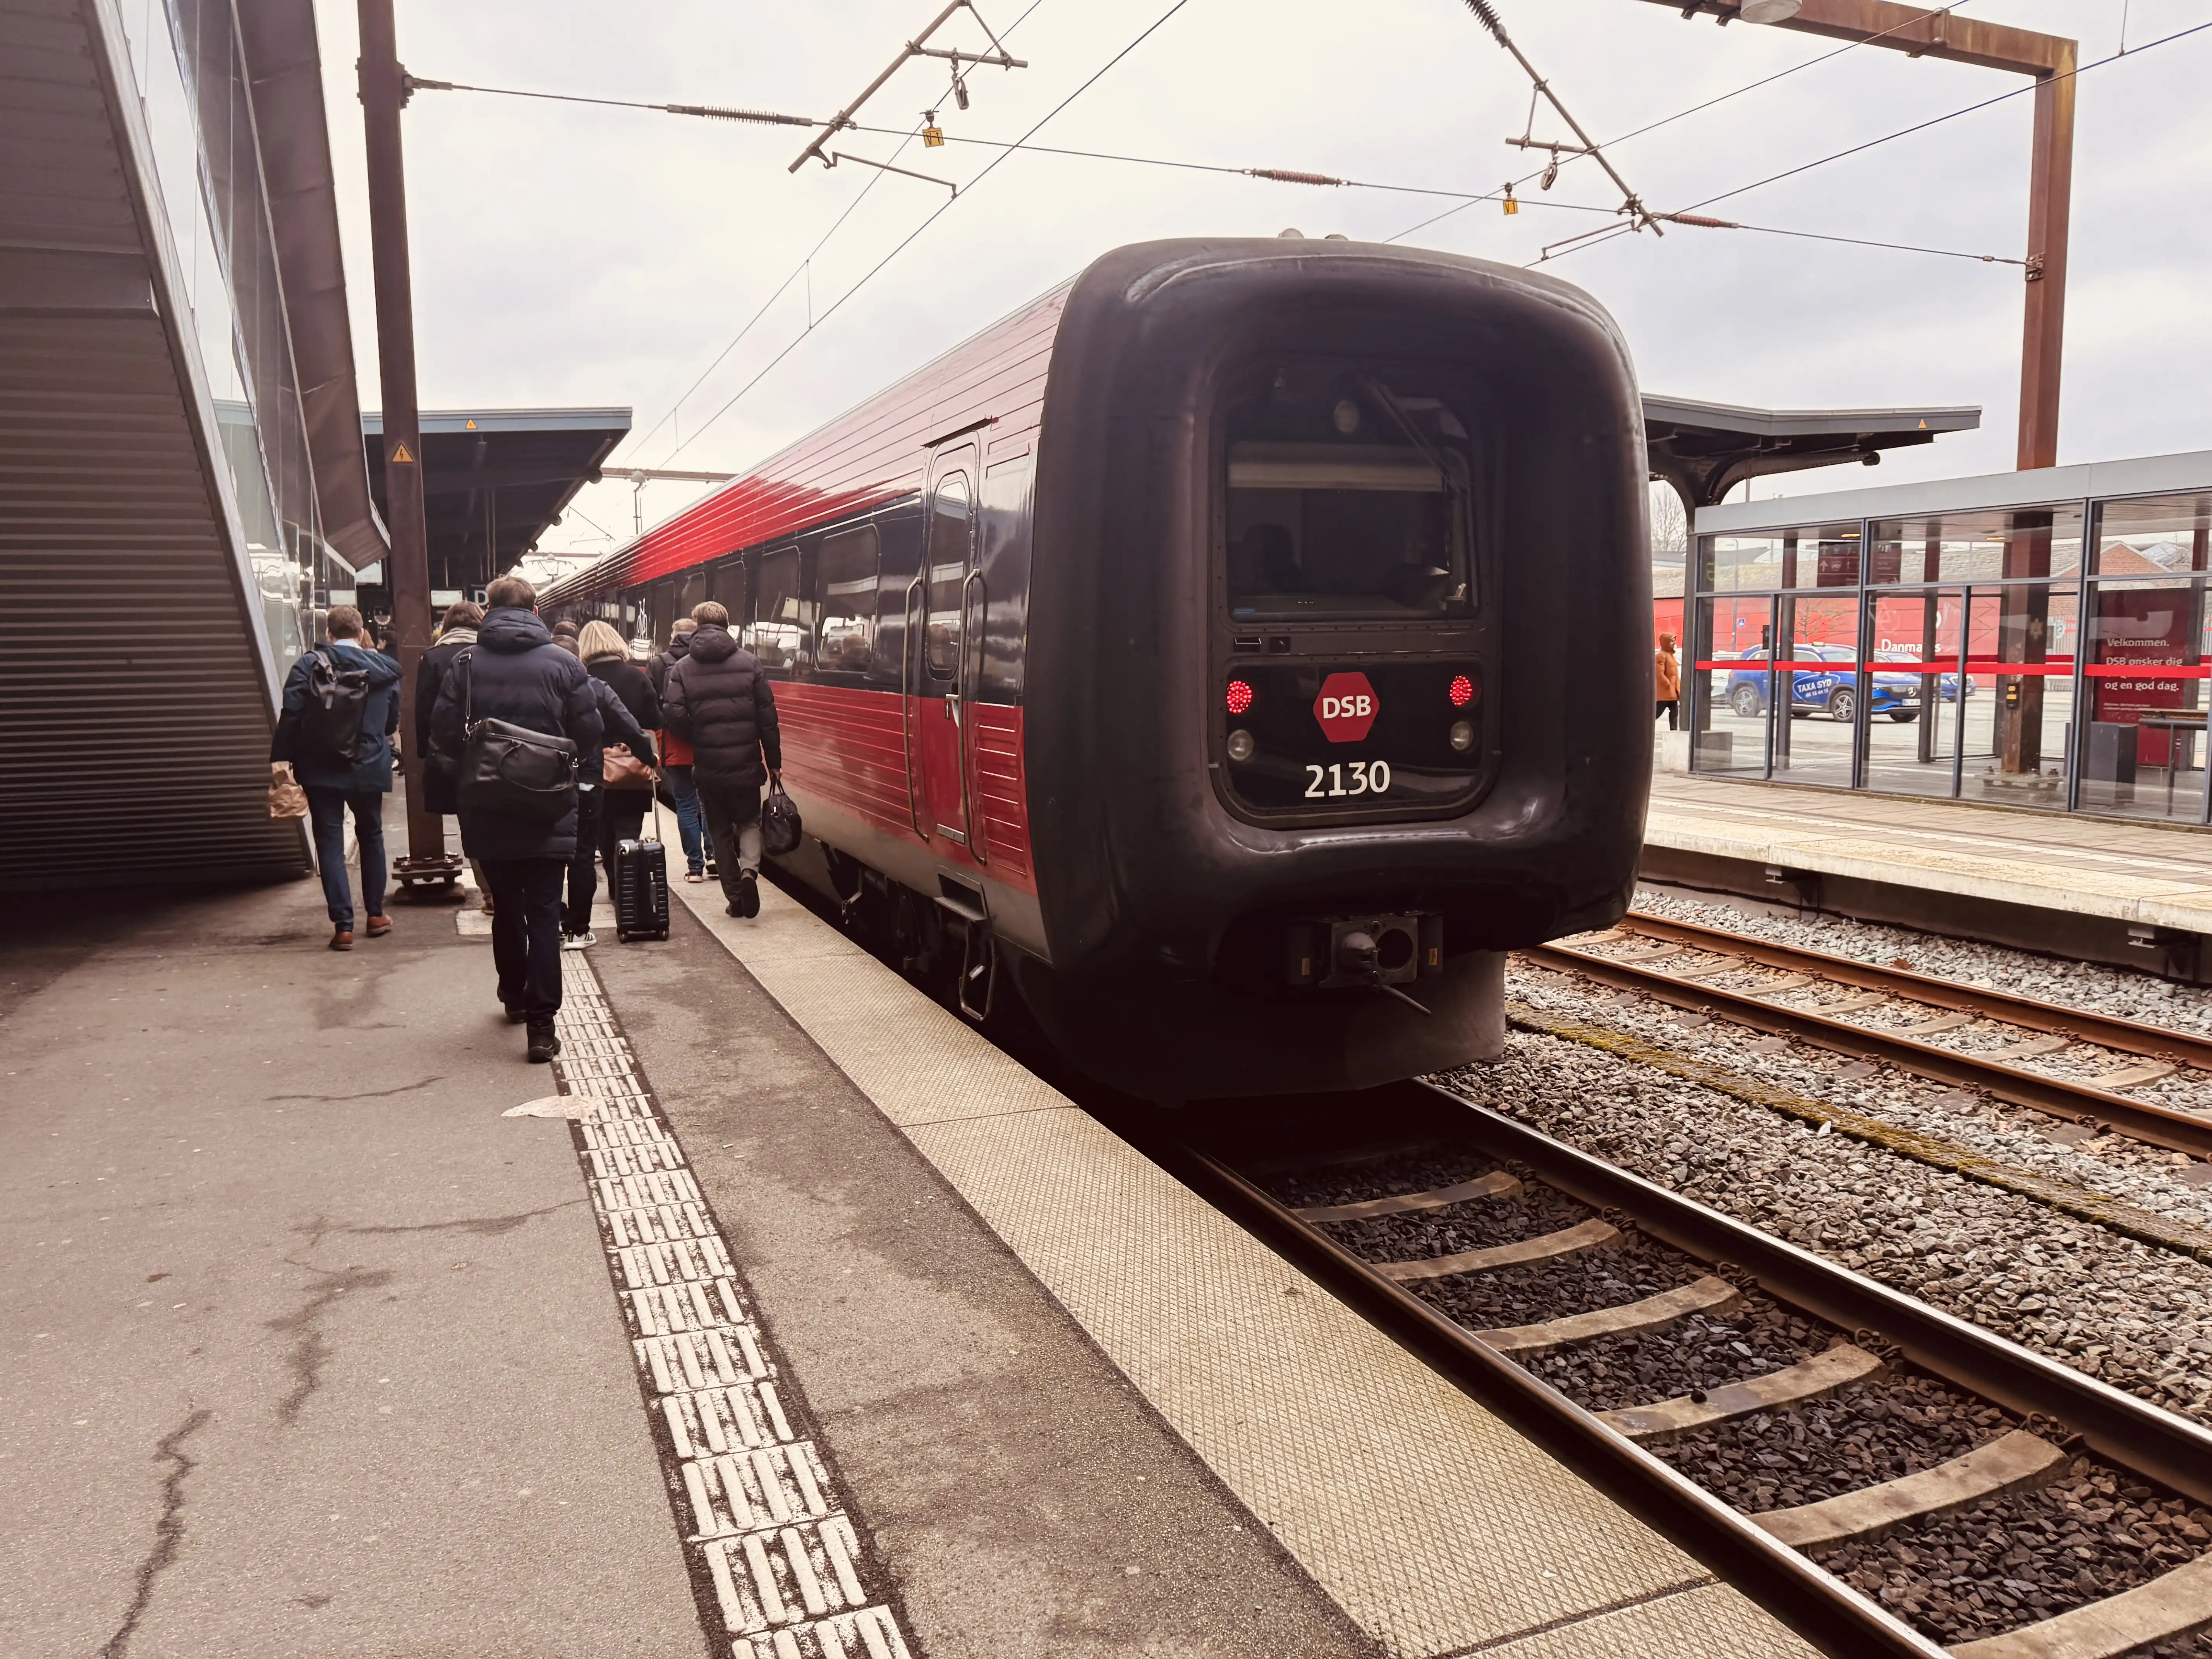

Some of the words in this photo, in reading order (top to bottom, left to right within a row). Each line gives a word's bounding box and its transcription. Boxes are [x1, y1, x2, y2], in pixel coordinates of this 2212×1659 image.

[1881, 638, 1941, 652] Danmas
[2107, 638, 2169, 646] Velkommen.
[2166, 657, 2183, 666] dig
[1797, 682, 1816, 693] TAXA
[1817, 678, 1832, 689] SYD
[2104, 682, 2118, 690] og
[2135, 681, 2154, 691] god
[2157, 681, 2179, 692] dag.
[1323, 695, 1371, 719] DSB
[1305, 760, 1390, 798] 2130
